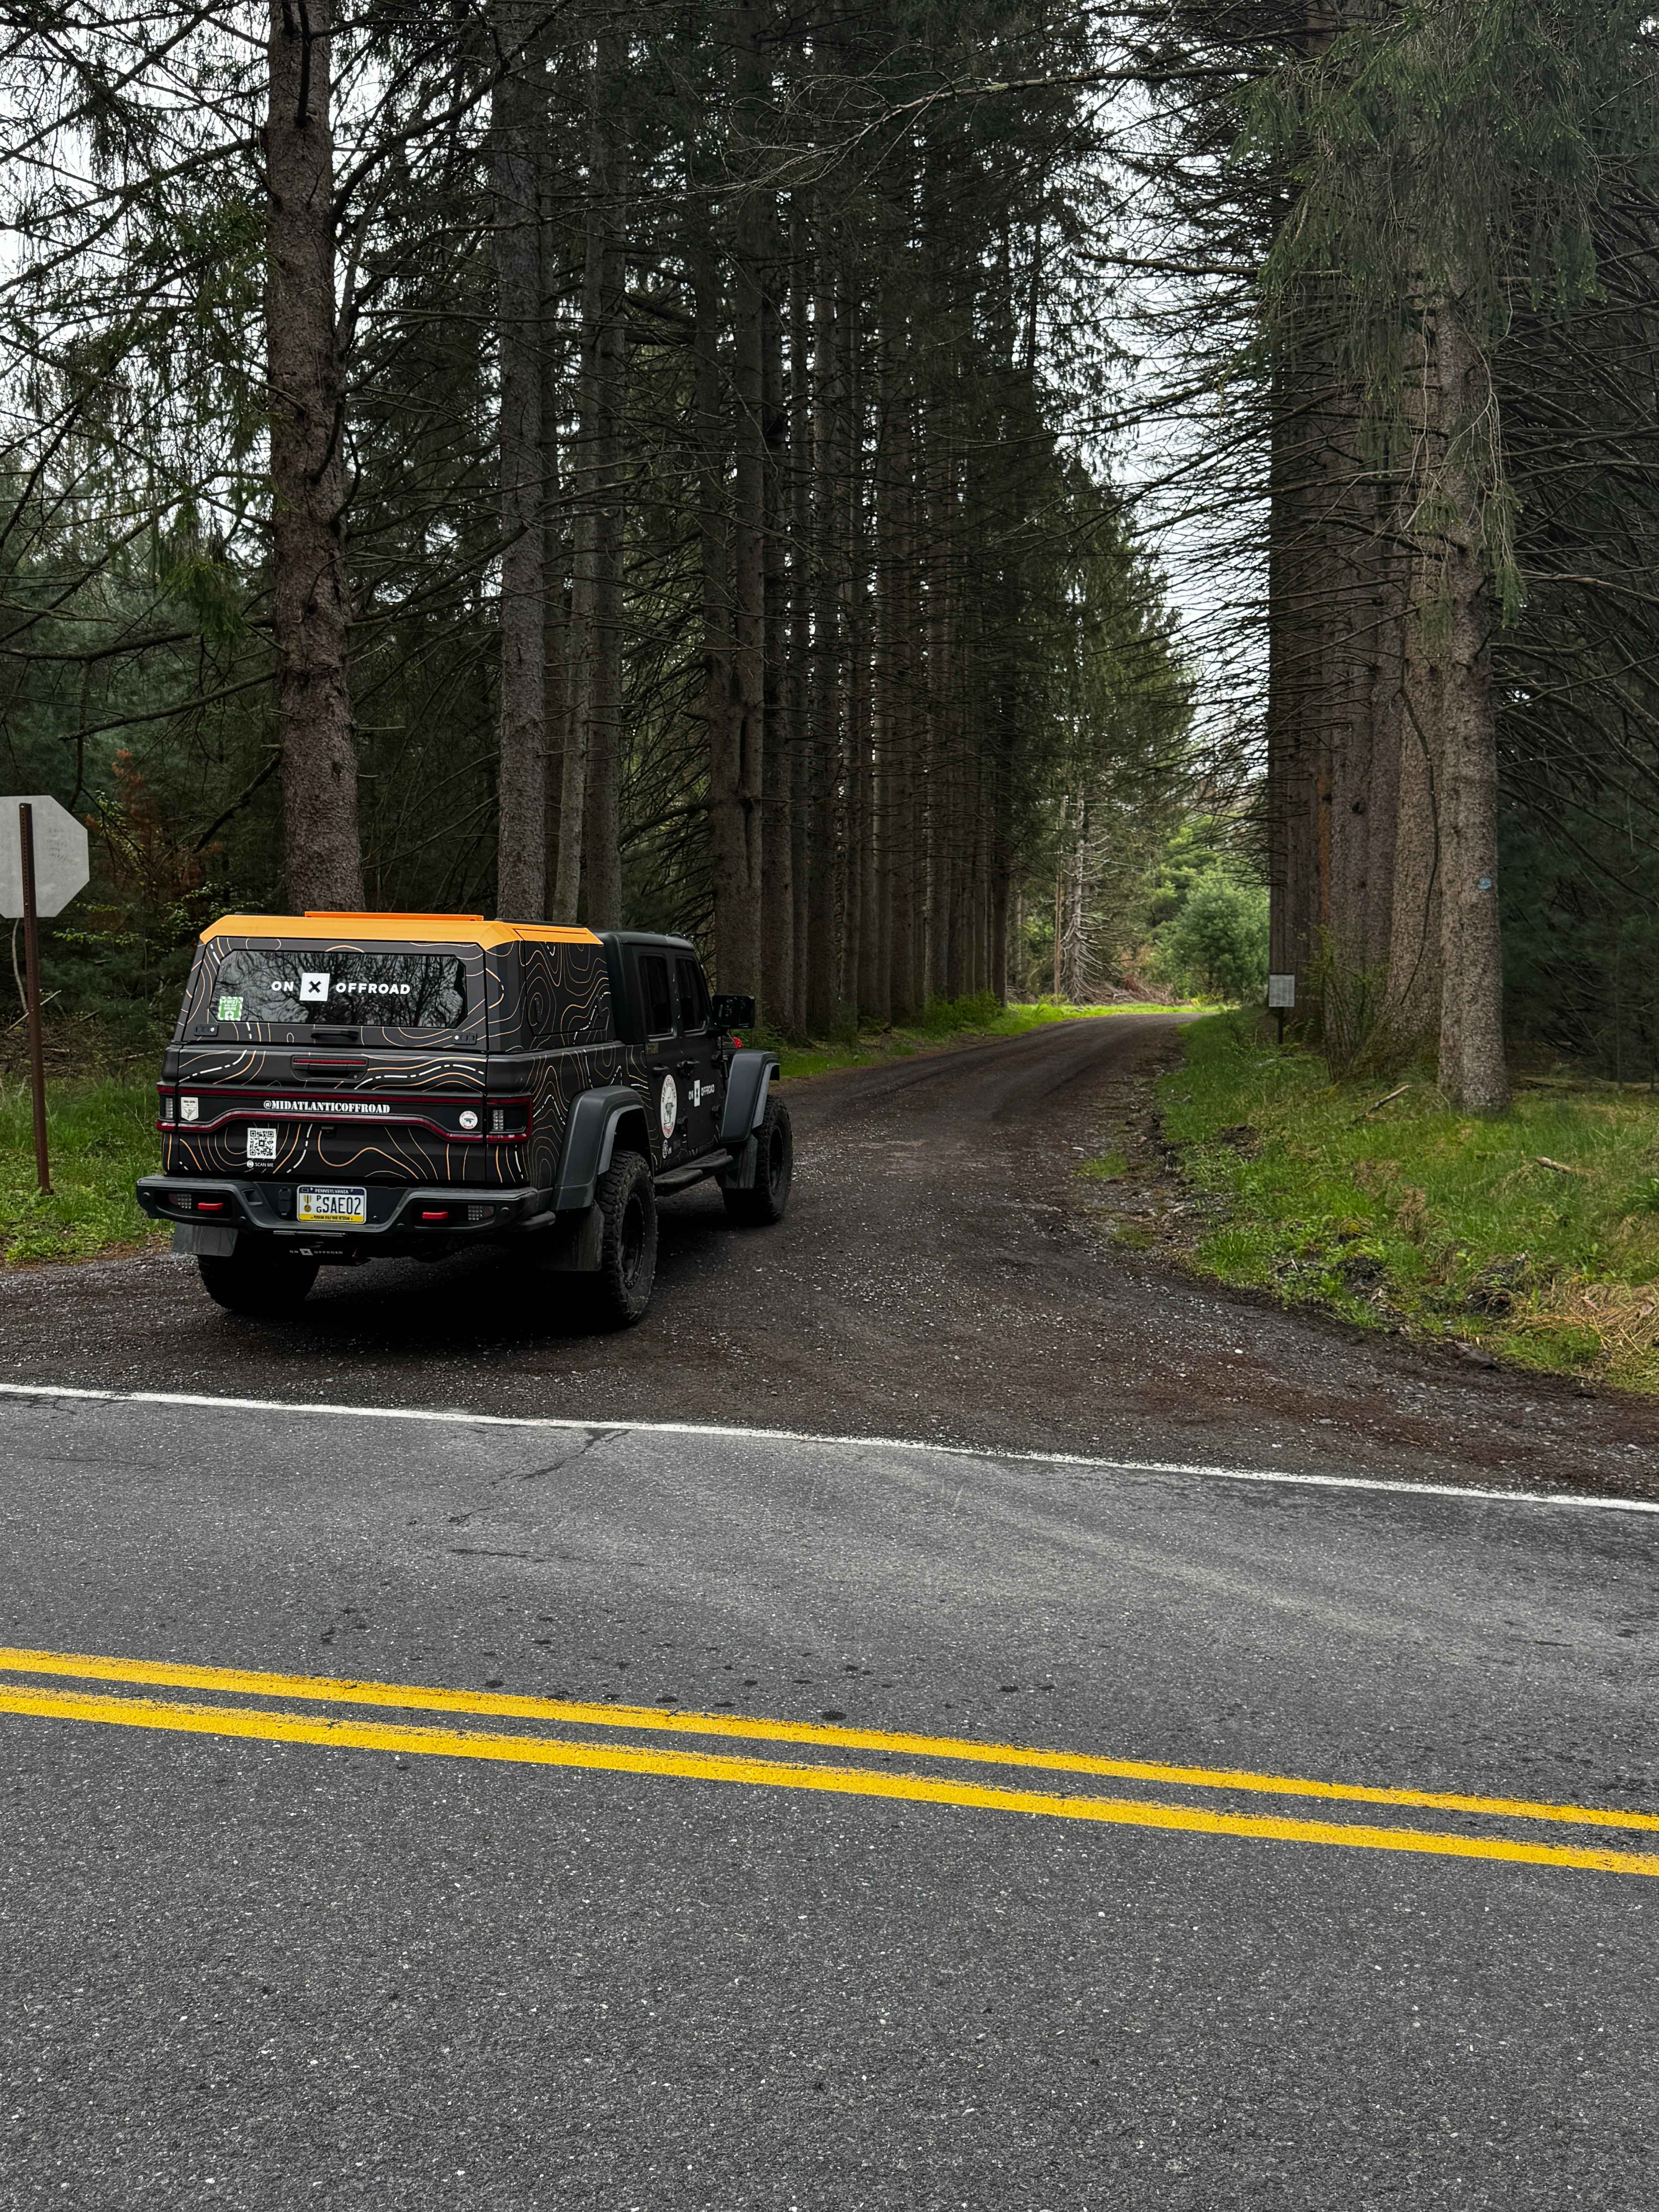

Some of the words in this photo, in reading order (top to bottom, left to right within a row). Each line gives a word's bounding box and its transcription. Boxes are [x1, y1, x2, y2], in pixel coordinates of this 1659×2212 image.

[271, 981, 294, 991] ON
[335, 982, 410, 994] OFFROAD
[263, 1100, 390, 1113] @MIDATLANTICOFFROAD
[323, 1197, 361, 1215] SAE02
